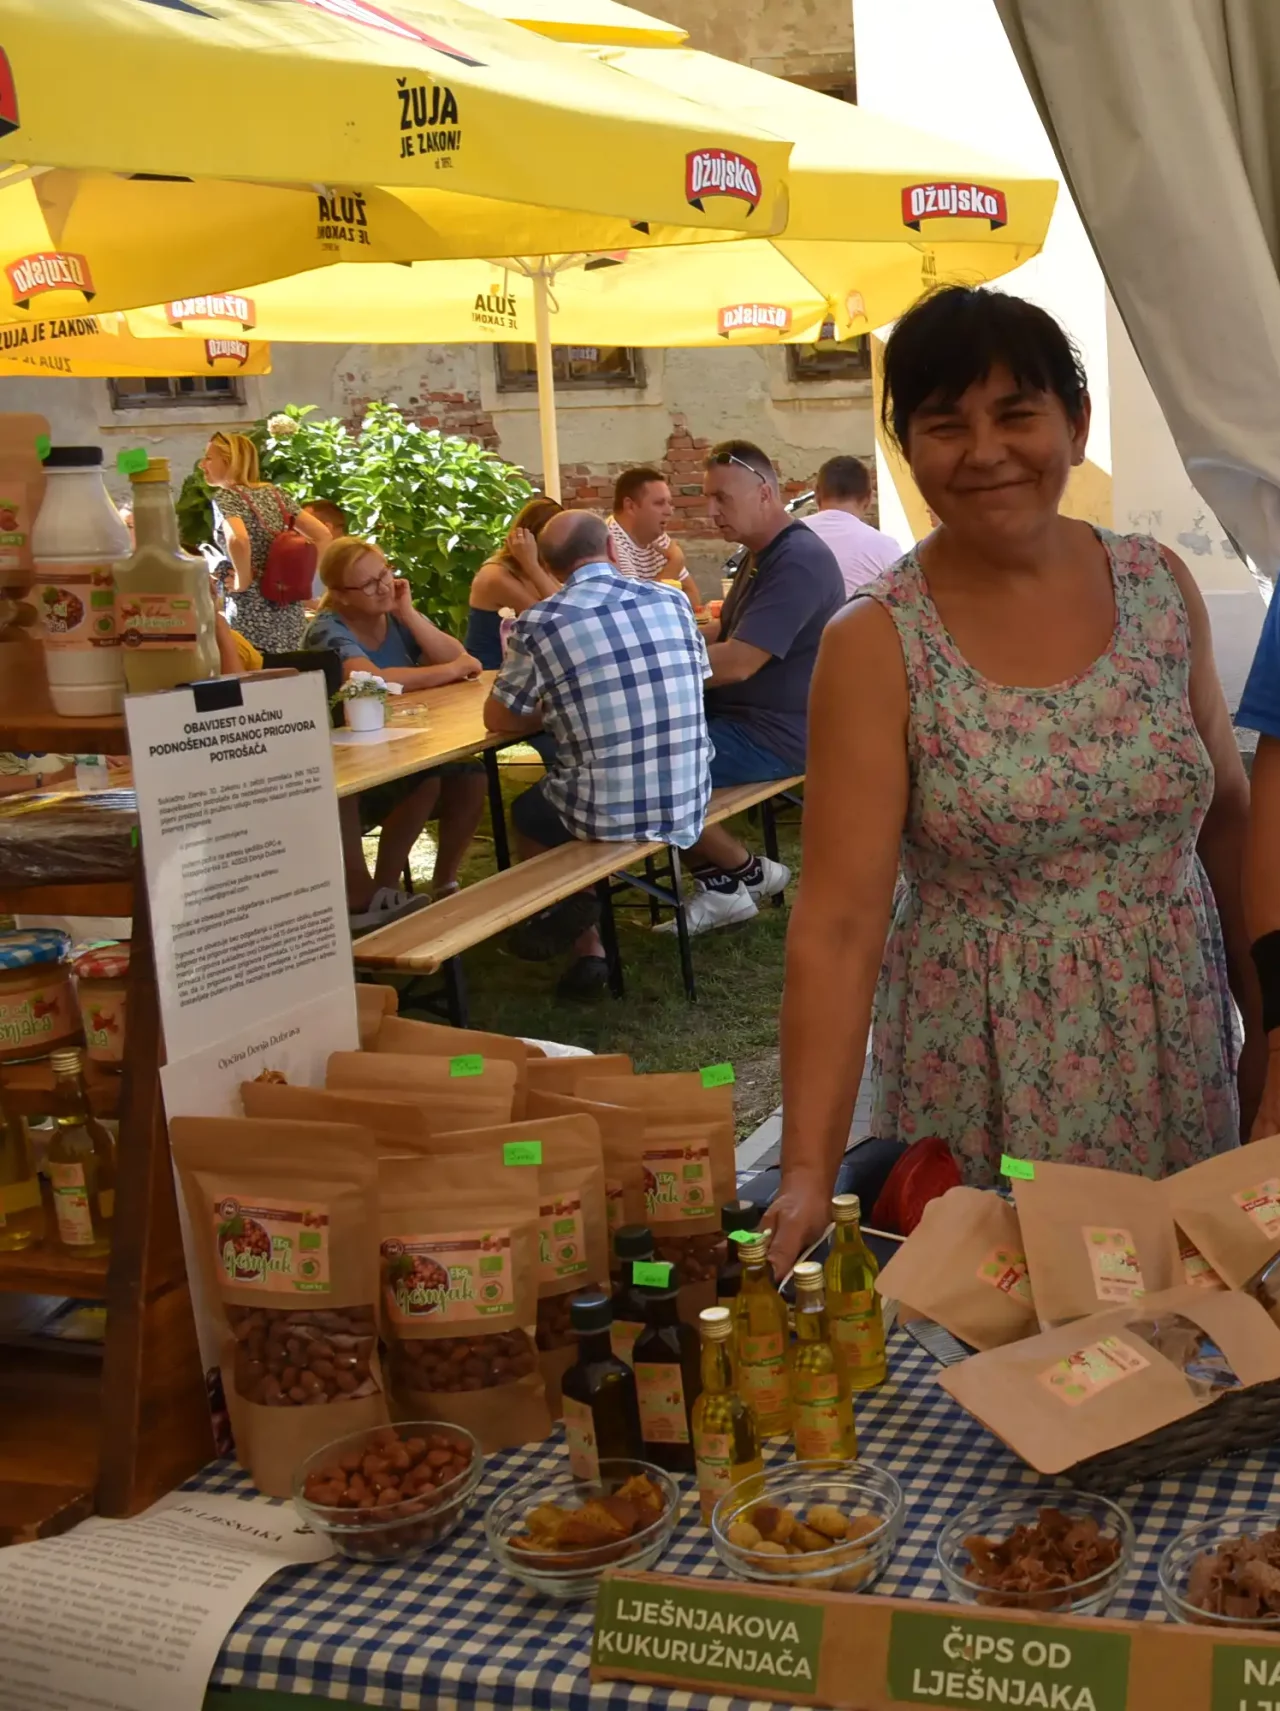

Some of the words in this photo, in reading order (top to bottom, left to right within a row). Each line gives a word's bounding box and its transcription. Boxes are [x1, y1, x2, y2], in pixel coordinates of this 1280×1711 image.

[396, 77, 458, 130] ŽUJA
[400, 136, 415, 158] JE
[417, 130, 461, 154] ZAKON!
[692, 152, 757, 196] Ožujsko
[911, 184, 999, 216] Ožujsko
[31, 322, 46, 343] JE
[49, 317, 99, 339] ZAKON!
[149, 737, 219, 757] PODNOŠENJA
[220, 728, 262, 747] PISANOG
[263, 719, 316, 738] PRIGOVORA
[183, 716, 237, 735] OBAVIJEST
[238, 715, 246, 726] O
[247, 709, 283, 725] NAČINU
[210, 743, 267, 763] POTROŠAČA
[616, 1598, 800, 1645] LJEŠNJAKOVA
[598, 1629, 813, 1681] KUKURUŽNJAČA
[942, 1625, 1015, 1664] ČIPS
[1022, 1640, 1072, 1669] OD
[911, 1668, 1098, 1711] LJEŠNJAKA
